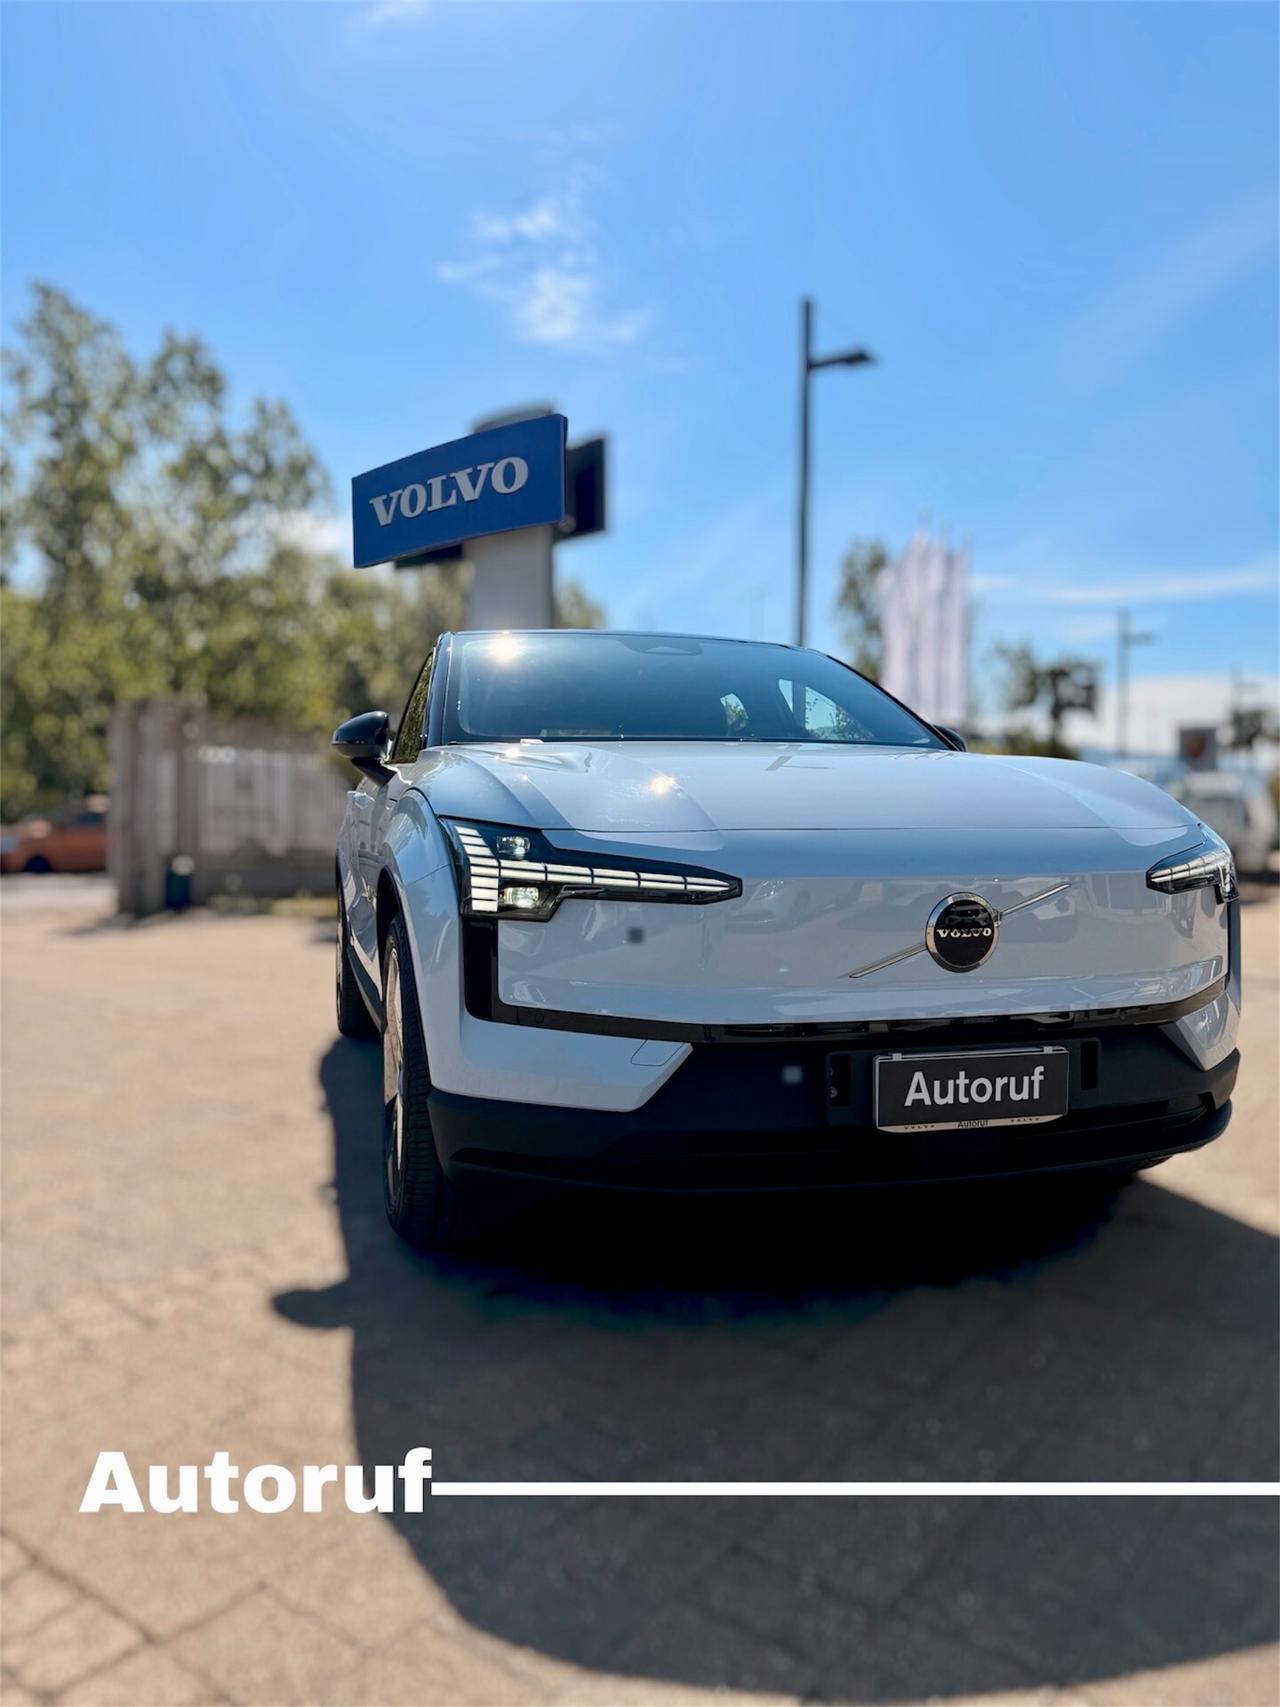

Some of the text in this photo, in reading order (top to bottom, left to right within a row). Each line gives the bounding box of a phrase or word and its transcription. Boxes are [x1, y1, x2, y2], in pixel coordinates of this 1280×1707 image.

[369, 456, 529, 526] VOLVO
[936, 927, 992, 938] VOLVO
[904, 1066, 1045, 1107] Autoruf
